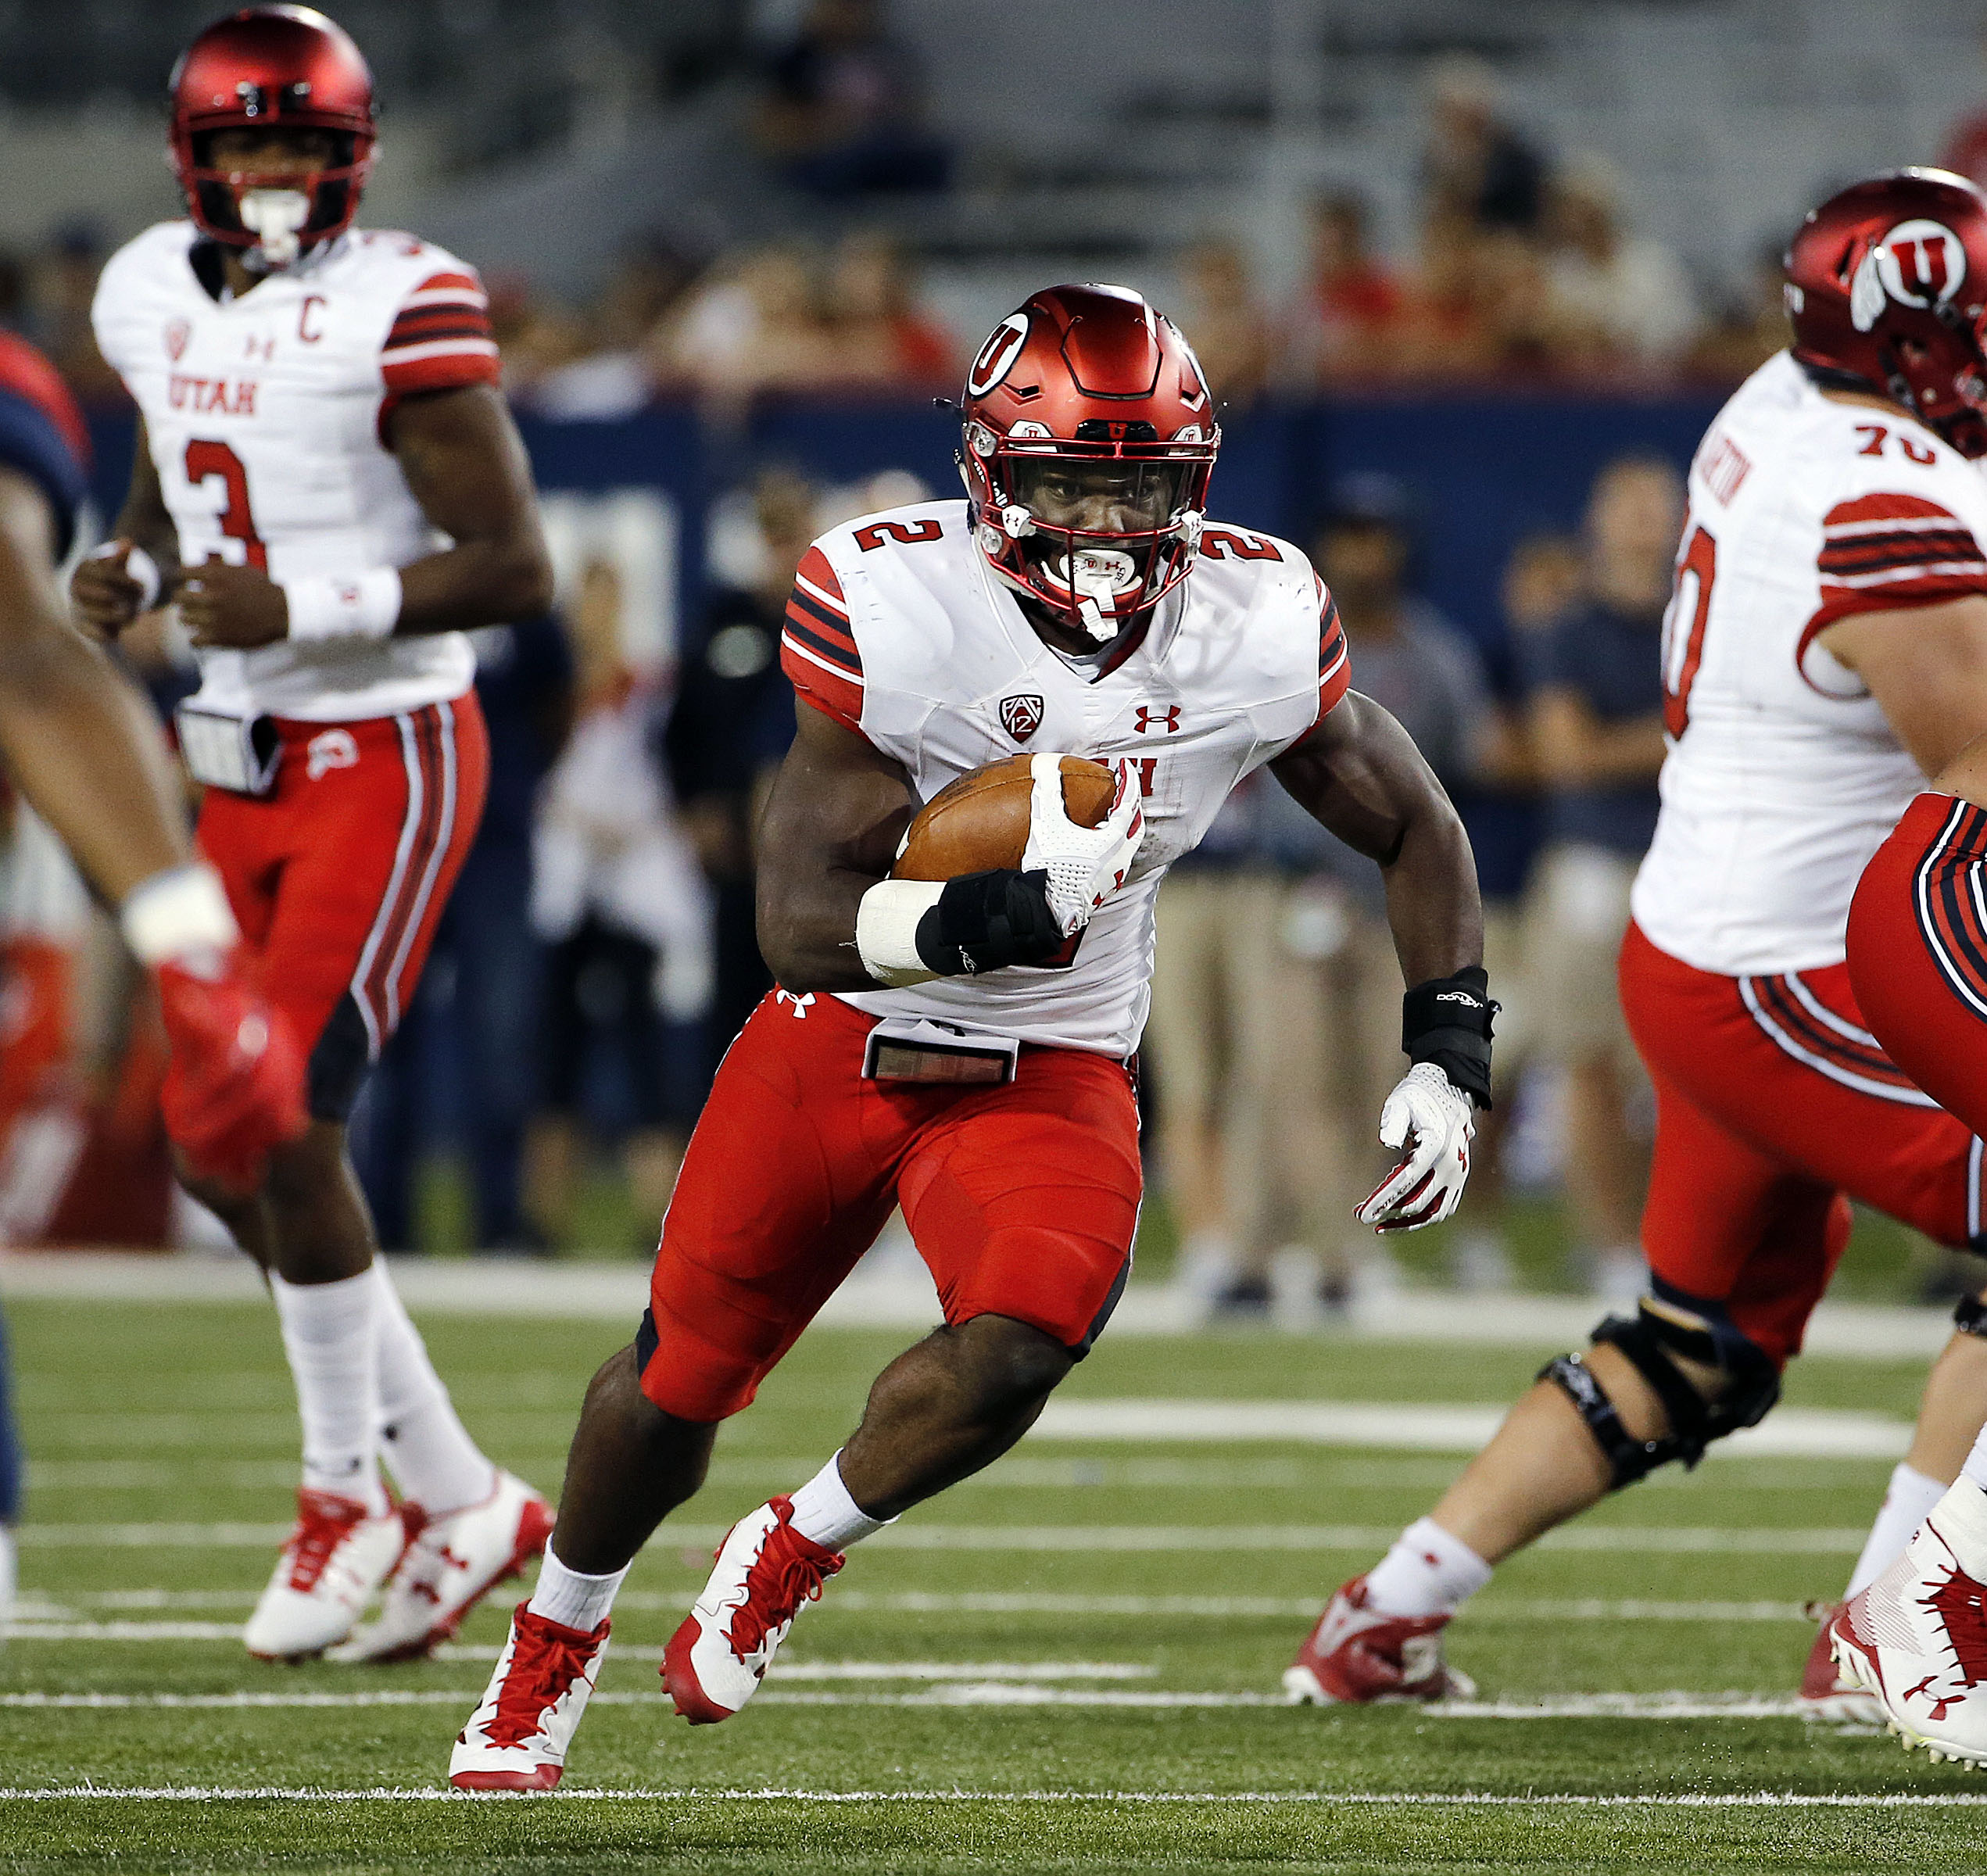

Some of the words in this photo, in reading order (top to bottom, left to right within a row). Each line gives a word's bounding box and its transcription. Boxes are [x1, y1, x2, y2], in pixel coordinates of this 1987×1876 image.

[1892, 237, 1947, 295] U
[299, 295, 327, 343] C
[971, 323, 1023, 388] U
[168, 374, 258, 415] UTAH
[1108, 422, 1127, 439] U
[185, 439, 268, 576] 3
[851, 519, 944, 553] 2
[1199, 530, 1284, 563] 2
[1001, 696, 1043, 725] PAC
[1011, 715, 1033, 733] 12
